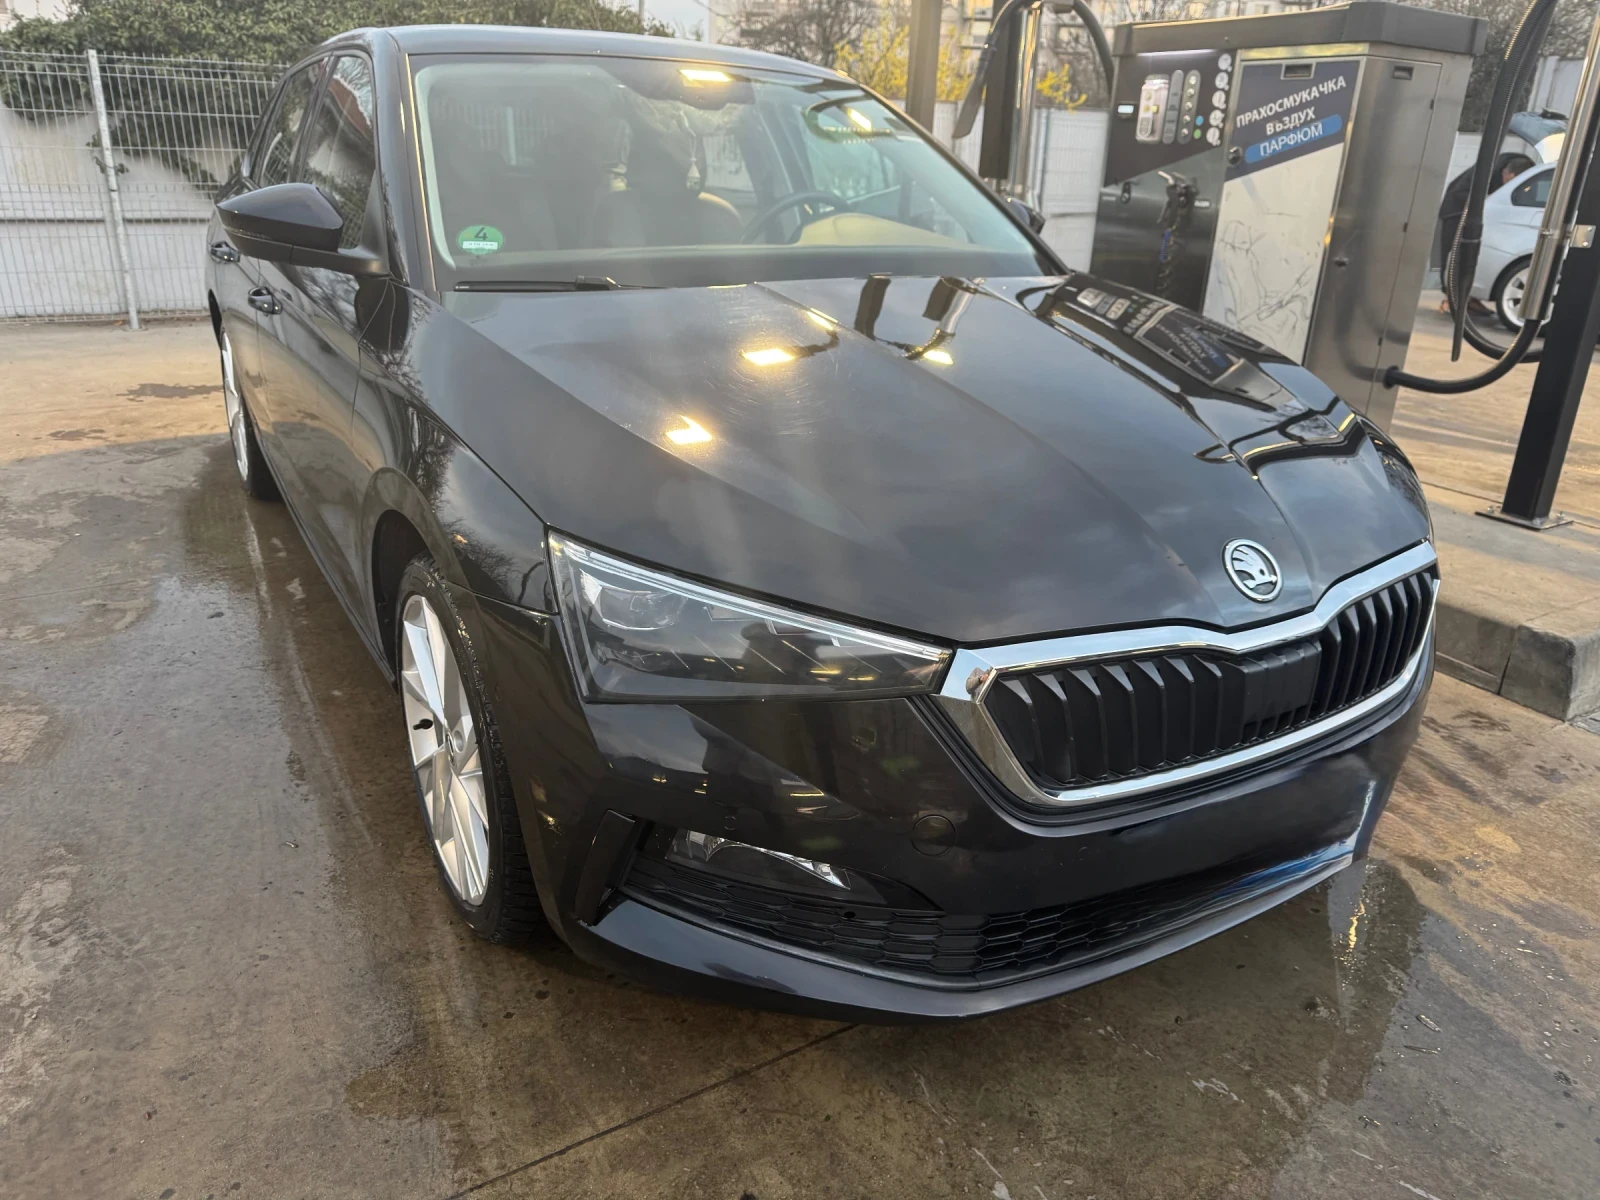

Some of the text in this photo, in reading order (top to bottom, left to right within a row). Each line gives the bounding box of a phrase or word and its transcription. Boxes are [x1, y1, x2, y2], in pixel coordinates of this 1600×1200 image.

[1236, 75, 1346, 128] ПРАХОСМУКАЧКА
[1260, 122, 1323, 156] ПАРФЮМ
[474, 227, 489, 241] 4
